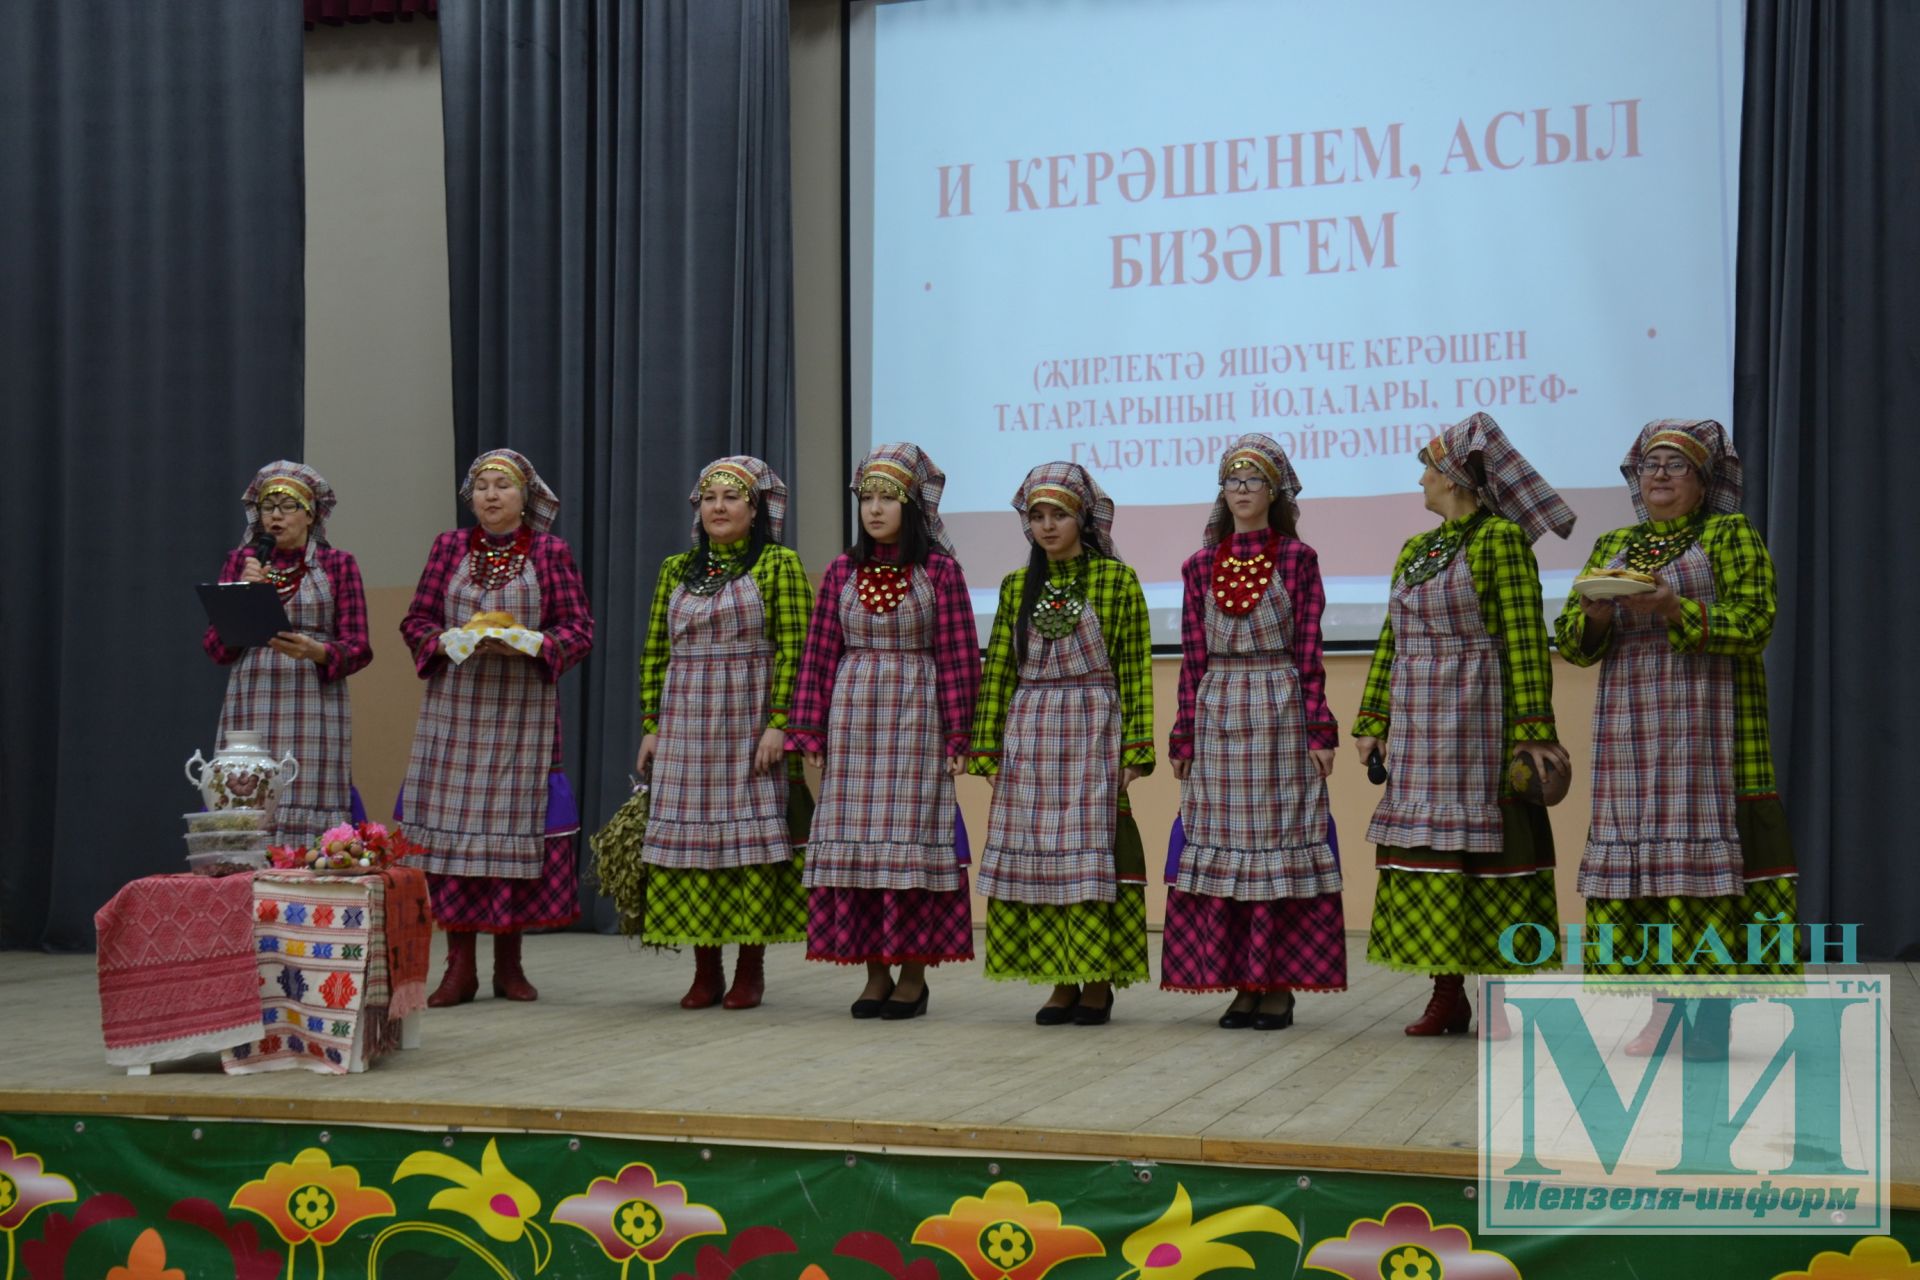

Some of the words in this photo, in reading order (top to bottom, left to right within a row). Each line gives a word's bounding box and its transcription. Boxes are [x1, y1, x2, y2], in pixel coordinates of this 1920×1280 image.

[936, 163, 974, 218] И
[1005, 122, 1421, 213] КЕРӘШЕНЕМ,
[1440, 98, 1643, 175] АСЫЛ
[1109, 211, 1400, 289] БИЗӘГЕМ
[1218, 340, 1355, 378] ЯШӘҮЧЕ
[1364, 330, 1527, 369] КЕРӘШЕН
[993, 391, 1236, 432] ТАТАРЛАРЫНЫҢ
[1455, 373, 1578, 408] ГОРЕФ-
